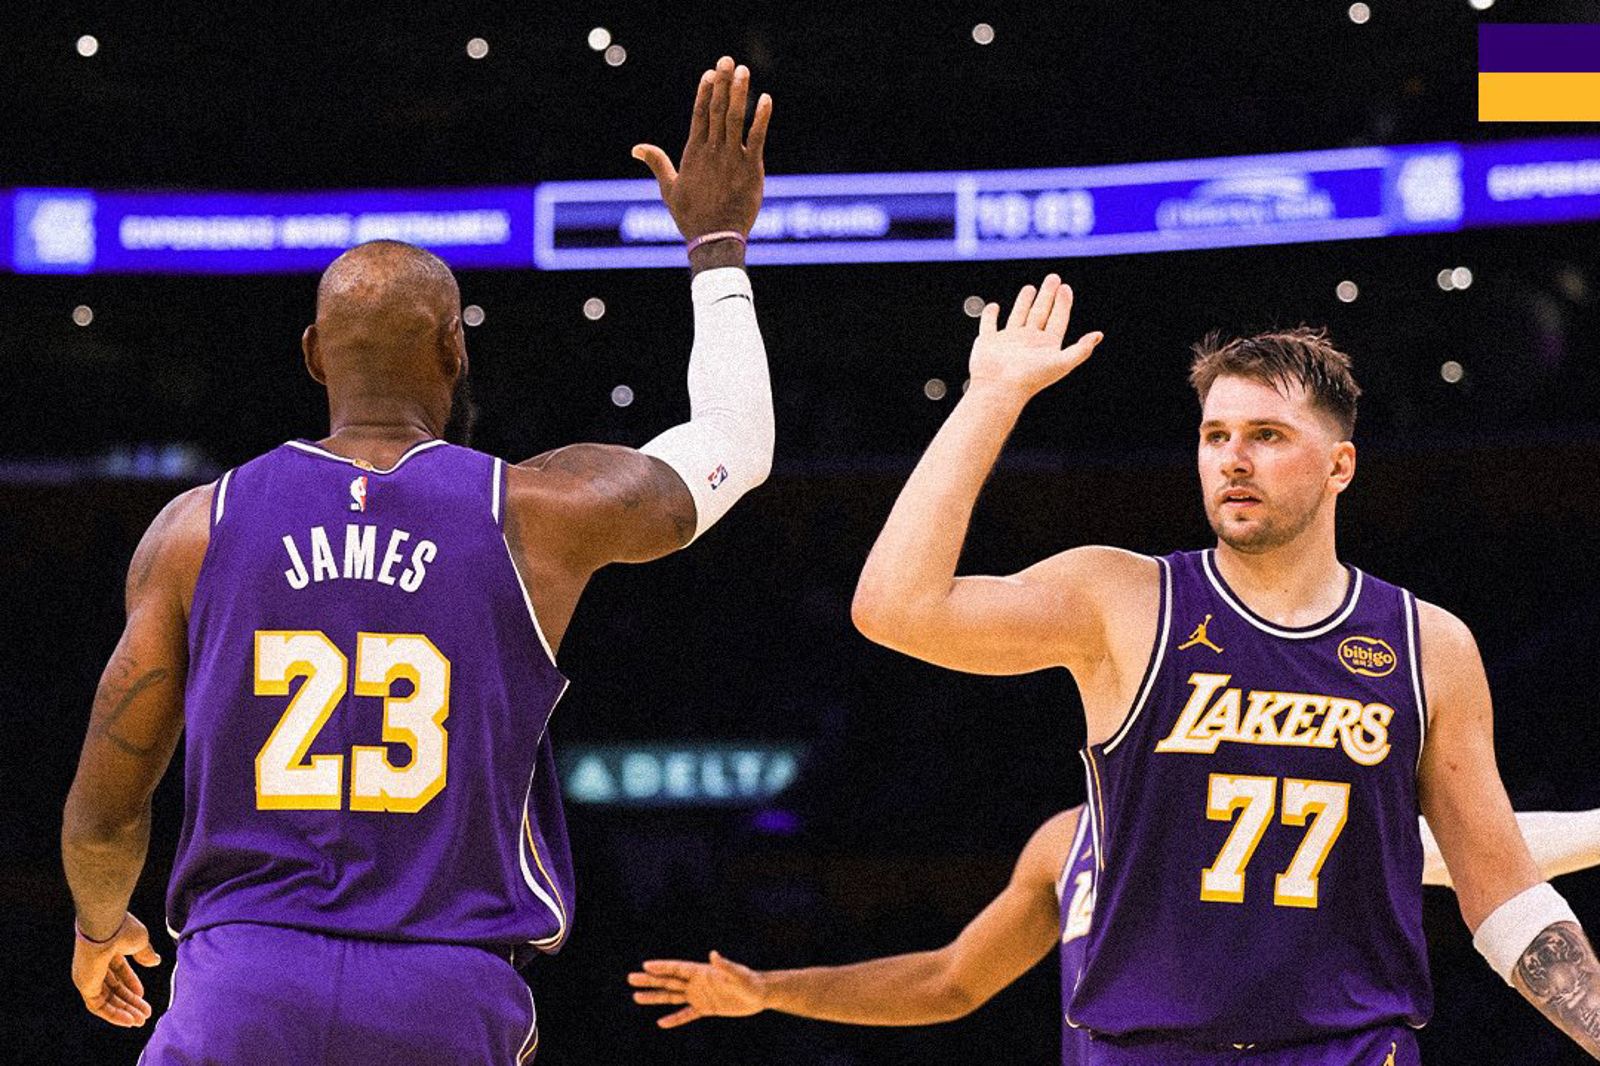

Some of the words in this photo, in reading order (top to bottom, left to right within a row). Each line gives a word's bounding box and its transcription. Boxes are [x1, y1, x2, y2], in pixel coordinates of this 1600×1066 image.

[282, 524, 438, 593] JAMES
[1343, 645, 1393, 667] bibigo
[254, 630, 451, 814] 23
[1154, 672, 1396, 766] LAKERS
[619, 752, 800, 799] DELTA
[1200, 773, 1351, 908] 77
